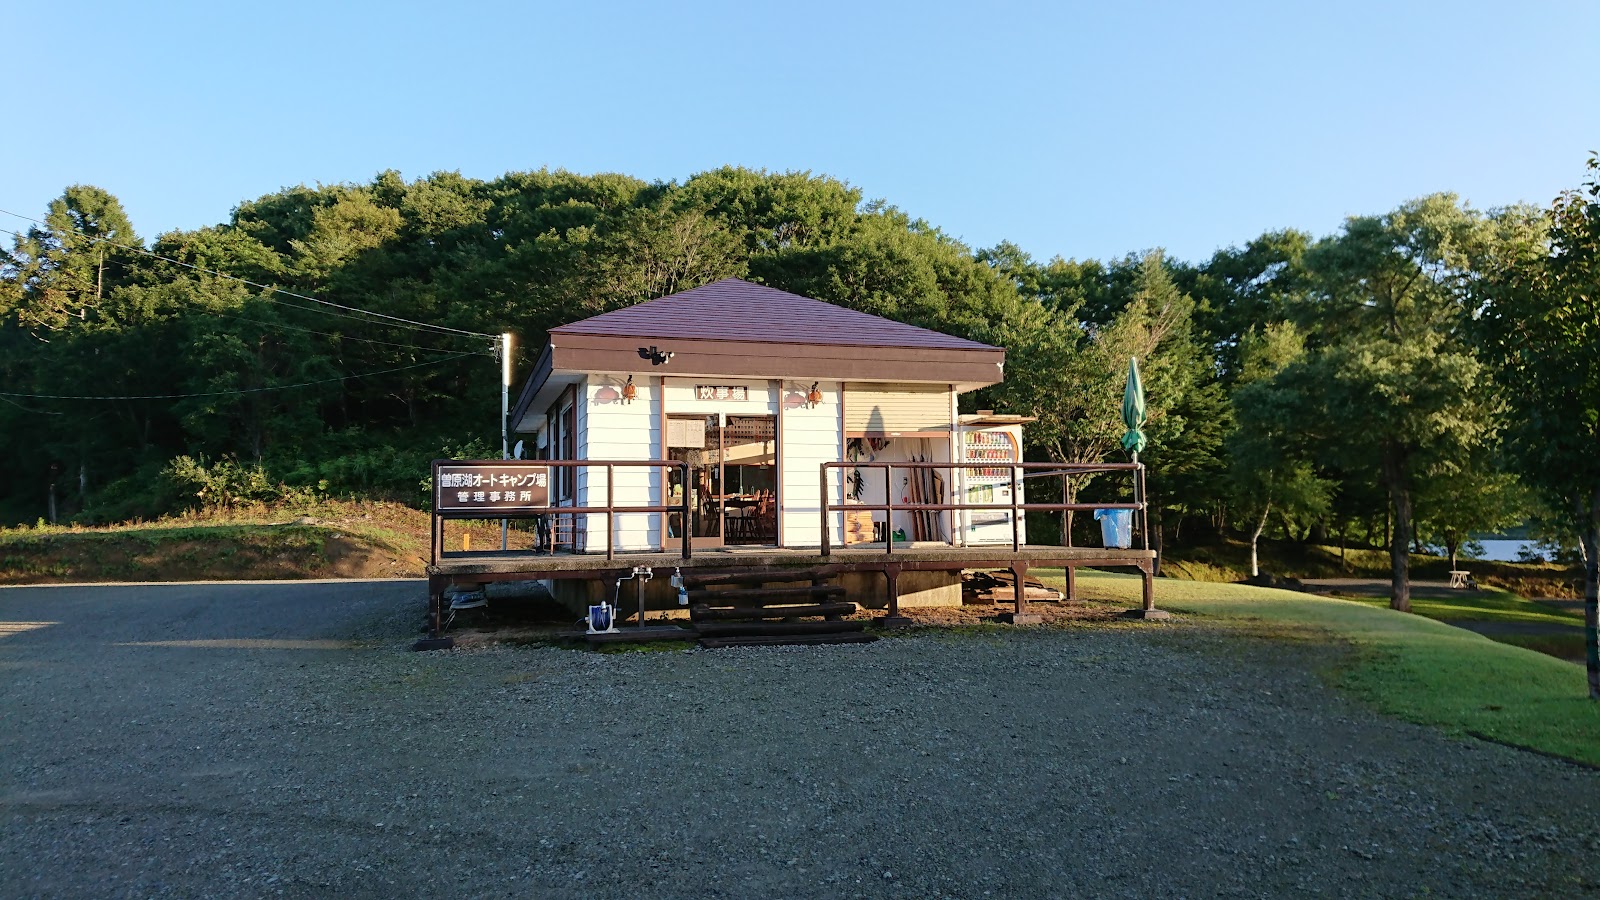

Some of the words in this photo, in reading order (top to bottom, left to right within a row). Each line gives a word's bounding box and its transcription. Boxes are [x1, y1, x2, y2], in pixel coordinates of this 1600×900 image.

[700, 386, 745, 399] 炊事場
[457, 491, 531, 502] 管理事務所
